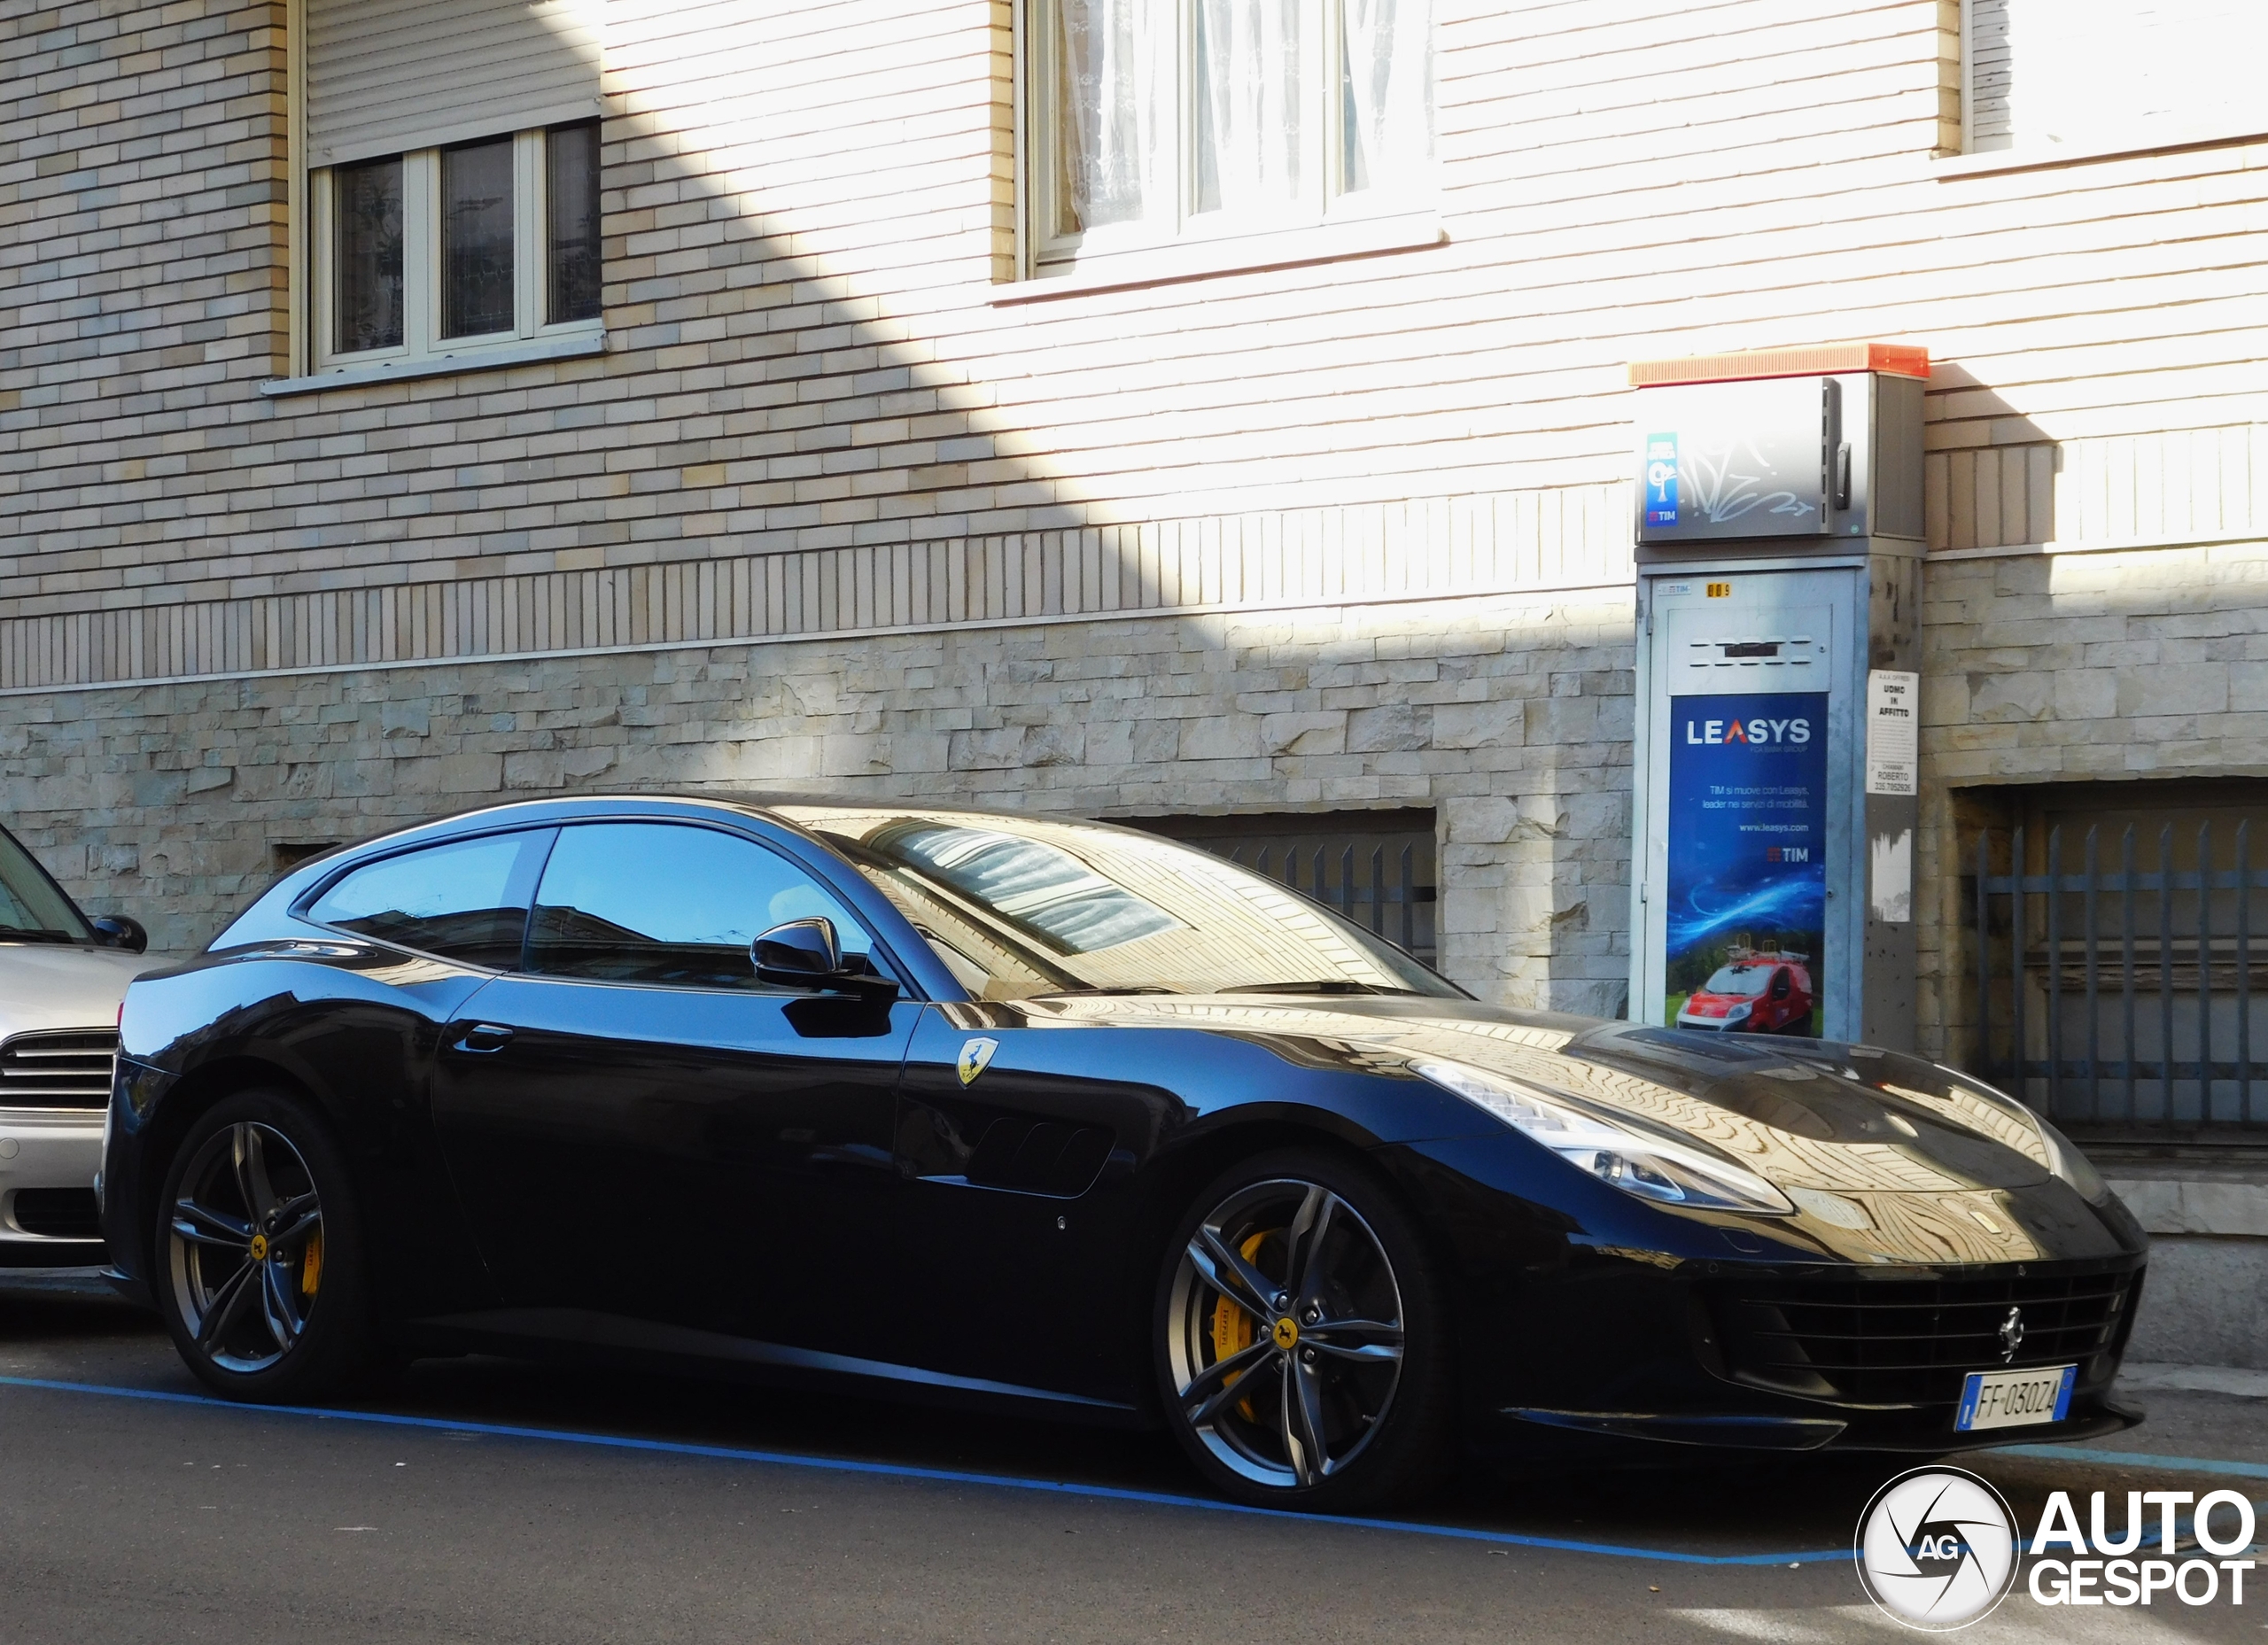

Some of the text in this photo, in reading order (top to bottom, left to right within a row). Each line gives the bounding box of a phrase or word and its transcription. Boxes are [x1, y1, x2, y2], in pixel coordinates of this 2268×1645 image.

[1658, 511, 1676, 521] TIM
[1884, 685, 1906, 694] UOMO
[1879, 707, 1909, 717] AFFITTO
[1687, 718, 1811, 744] LEASYS
[1877, 771, 1908, 780] ROBERTO
[1710, 786, 1724, 795] TIM
[1726, 786, 1733, 795] si
[1767, 799, 1774, 808] di
[1739, 824, 1809, 834] www.leasys.com
[1783, 848, 1808, 863] TIM
